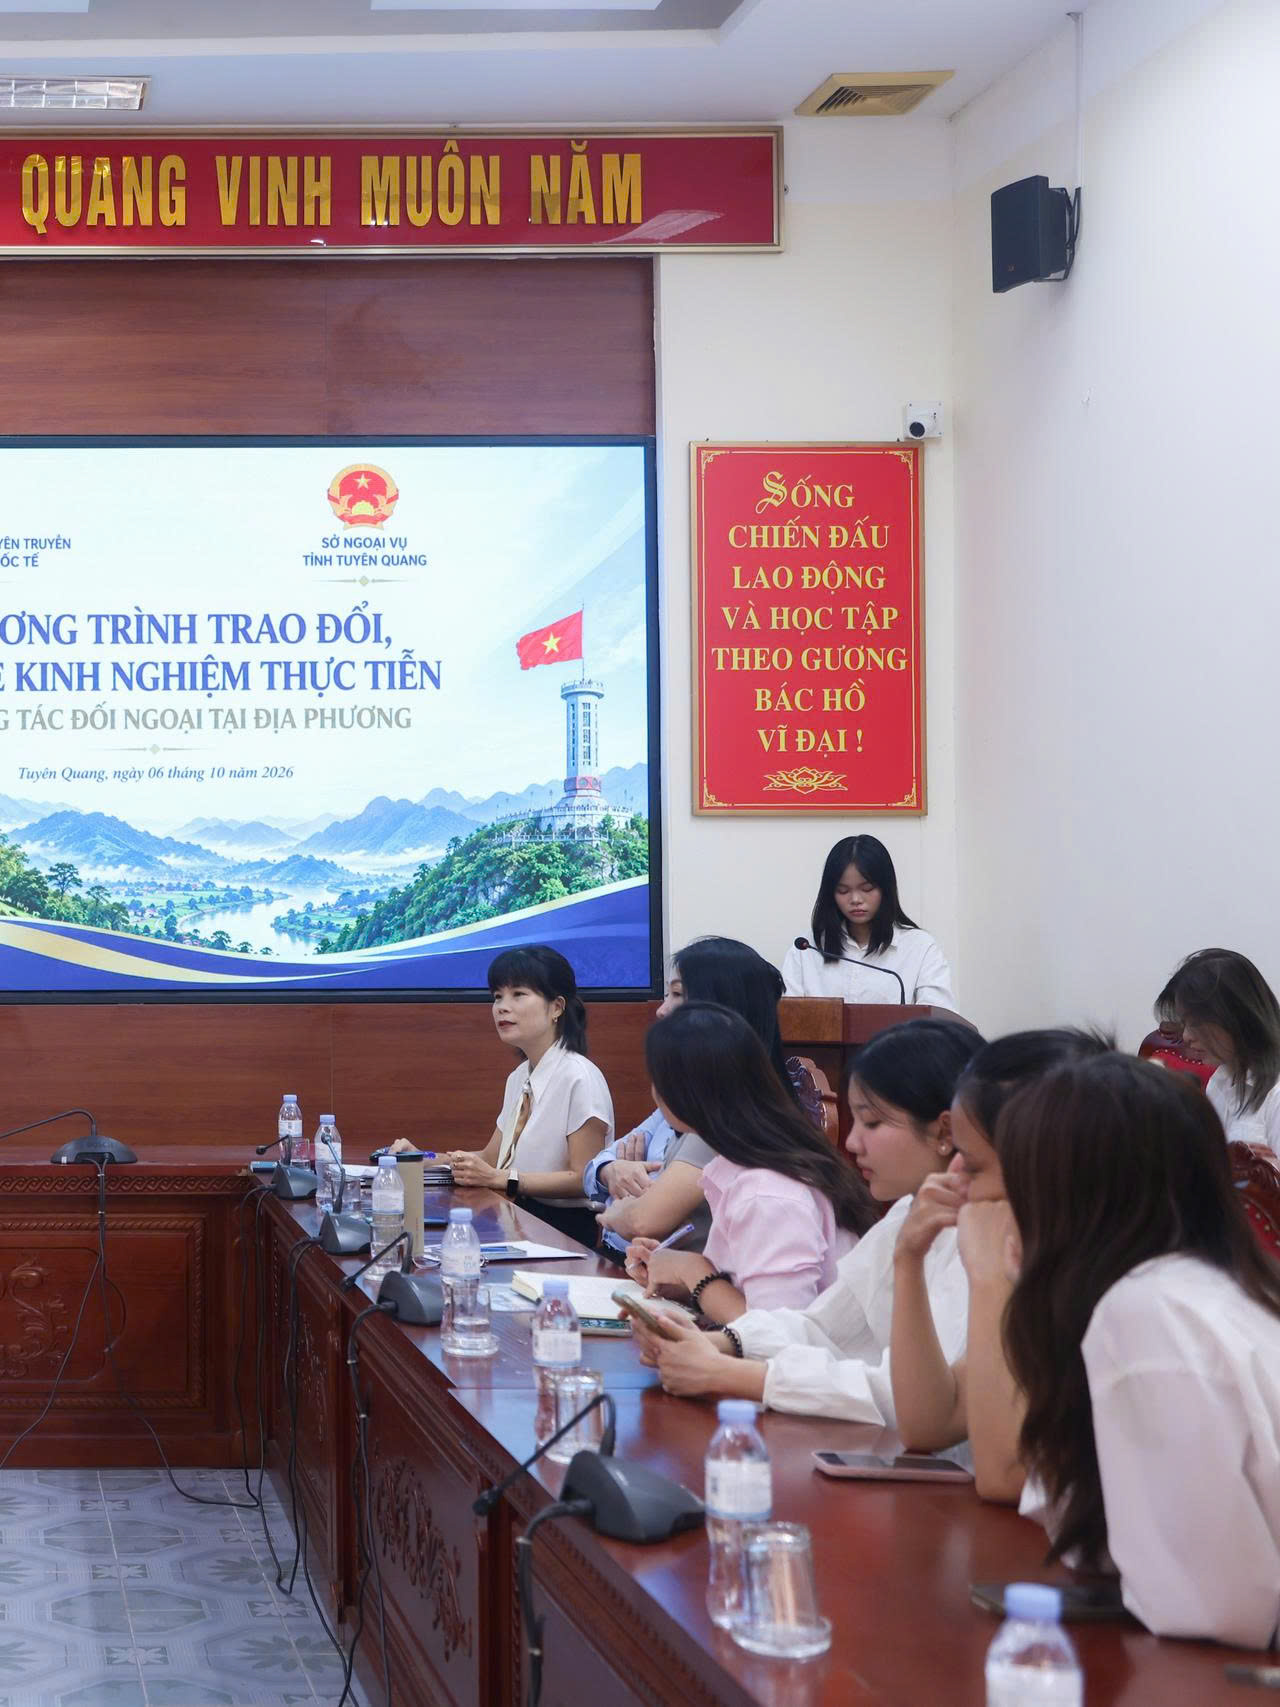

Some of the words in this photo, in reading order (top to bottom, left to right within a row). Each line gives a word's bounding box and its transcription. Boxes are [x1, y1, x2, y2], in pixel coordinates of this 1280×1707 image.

[22, 154, 185, 234] QUANG
[216, 156, 331, 225] VINH
[362, 140, 502, 227] MUÔN
[530, 140, 643, 226] NĂM
[756, 471, 854, 514] SỐNG
[322, 534, 340, 548] SỞ
[344, 537, 385, 550] NGOẠI
[389, 537, 407, 551] VỤ
[729, 516, 820, 548] CHIẾN
[829, 516, 889, 548] ĐẤU
[23, 552, 39, 567] TẾ
[336, 552, 377, 566] TUYÊN
[381, 555, 427, 566] QUANG
[733, 566, 793, 589] LAO
[801, 560, 885, 594] ĐỘNG
[87, 606, 197, 644] TRÌNH
[208, 613, 306, 644] TRAO
[316, 601, 392, 649] ĐỔI,
[721, 600, 760, 629] VÀ
[770, 607, 832, 635] HỌC
[841, 601, 898, 635] TẬP
[15, 662, 100, 691] KINH
[111, 654, 250, 698] NGHIỆM
[260, 657, 355, 698] THỰC
[364, 649, 442, 690] TIỄN
[712, 648, 792, 670] THEO
[801, 645, 907, 670] GƯƠNG
[755, 682, 813, 711] BÁC
[823, 678, 865, 711] HỒ
[16, 704, 63, 730] TÁC
[70, 701, 116, 730] ĐỐI
[124, 708, 202, 734] NGOẠI
[208, 708, 246, 734] TẠI
[254, 708, 297, 734] ĐỊA
[304, 705, 411, 729] PHƯƠNG
[757, 725, 787, 752] VĨ
[796, 729, 847, 757] ĐẠI
[19, 768, 56, 783] Tuyên
[61, 767, 108, 783] Quang,
[113, 767, 144, 782] ngày
[148, 766, 164, 779] 06
[168, 766, 204, 782] tháng
[210, 766, 226, 779] 10
[229, 766, 258, 779] năm
[262, 766, 294, 779] 2026
